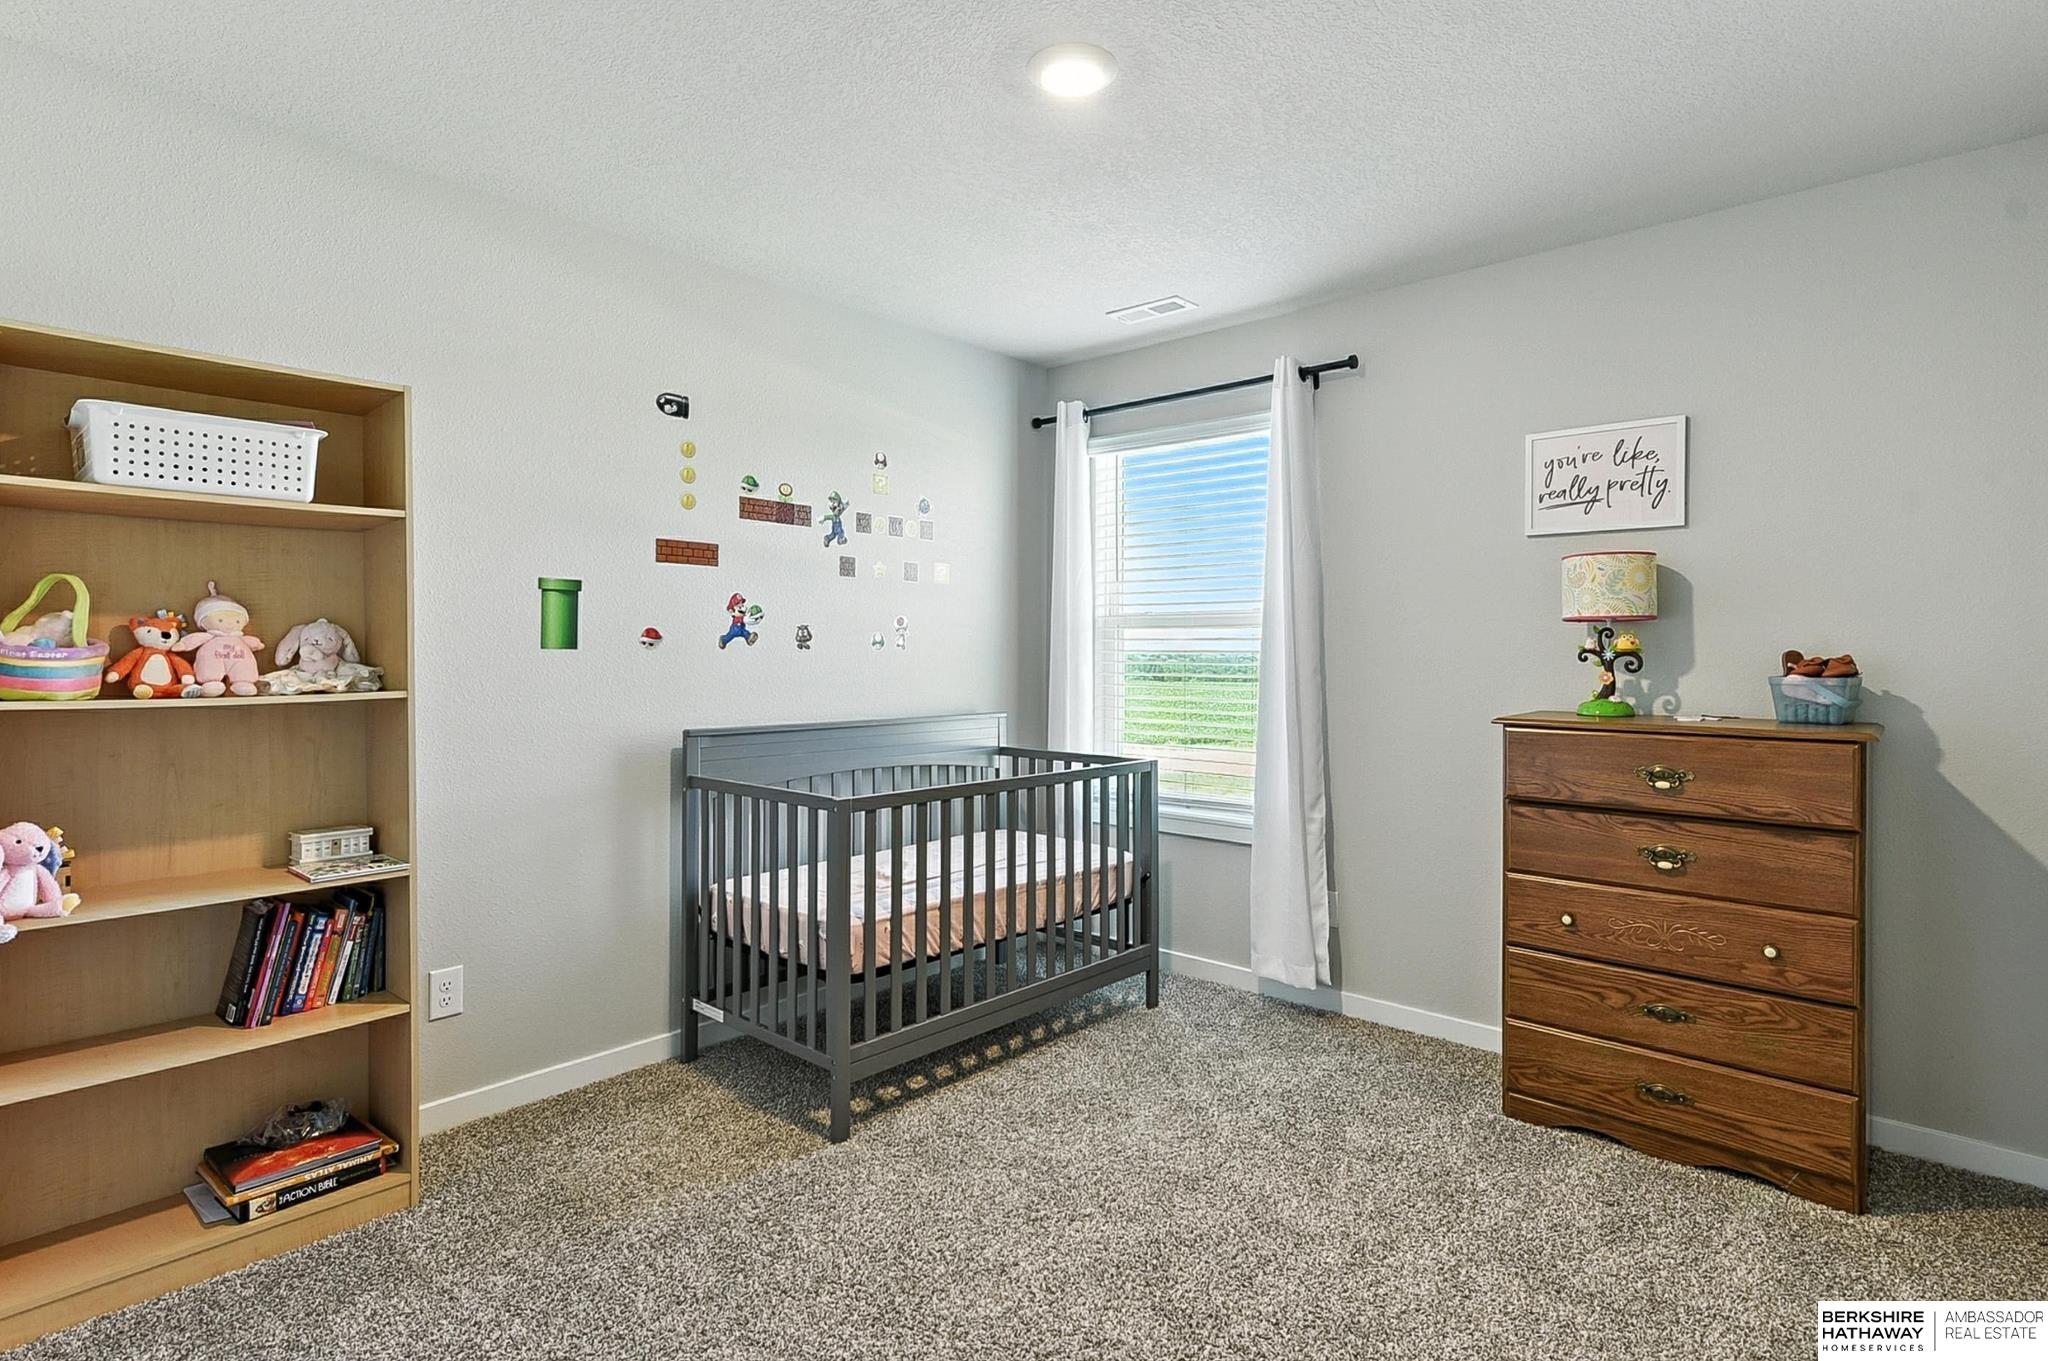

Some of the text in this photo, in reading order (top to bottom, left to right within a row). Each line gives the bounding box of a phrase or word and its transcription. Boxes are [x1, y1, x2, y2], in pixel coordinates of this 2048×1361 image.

[1613, 436, 1661, 469] like,
[1538, 465, 1672, 515] really pretty.
[29, 650, 69, 659] Easter
[304, 1164, 340, 1182] ATLAS
[318, 1177, 338, 1192] BIBLE
